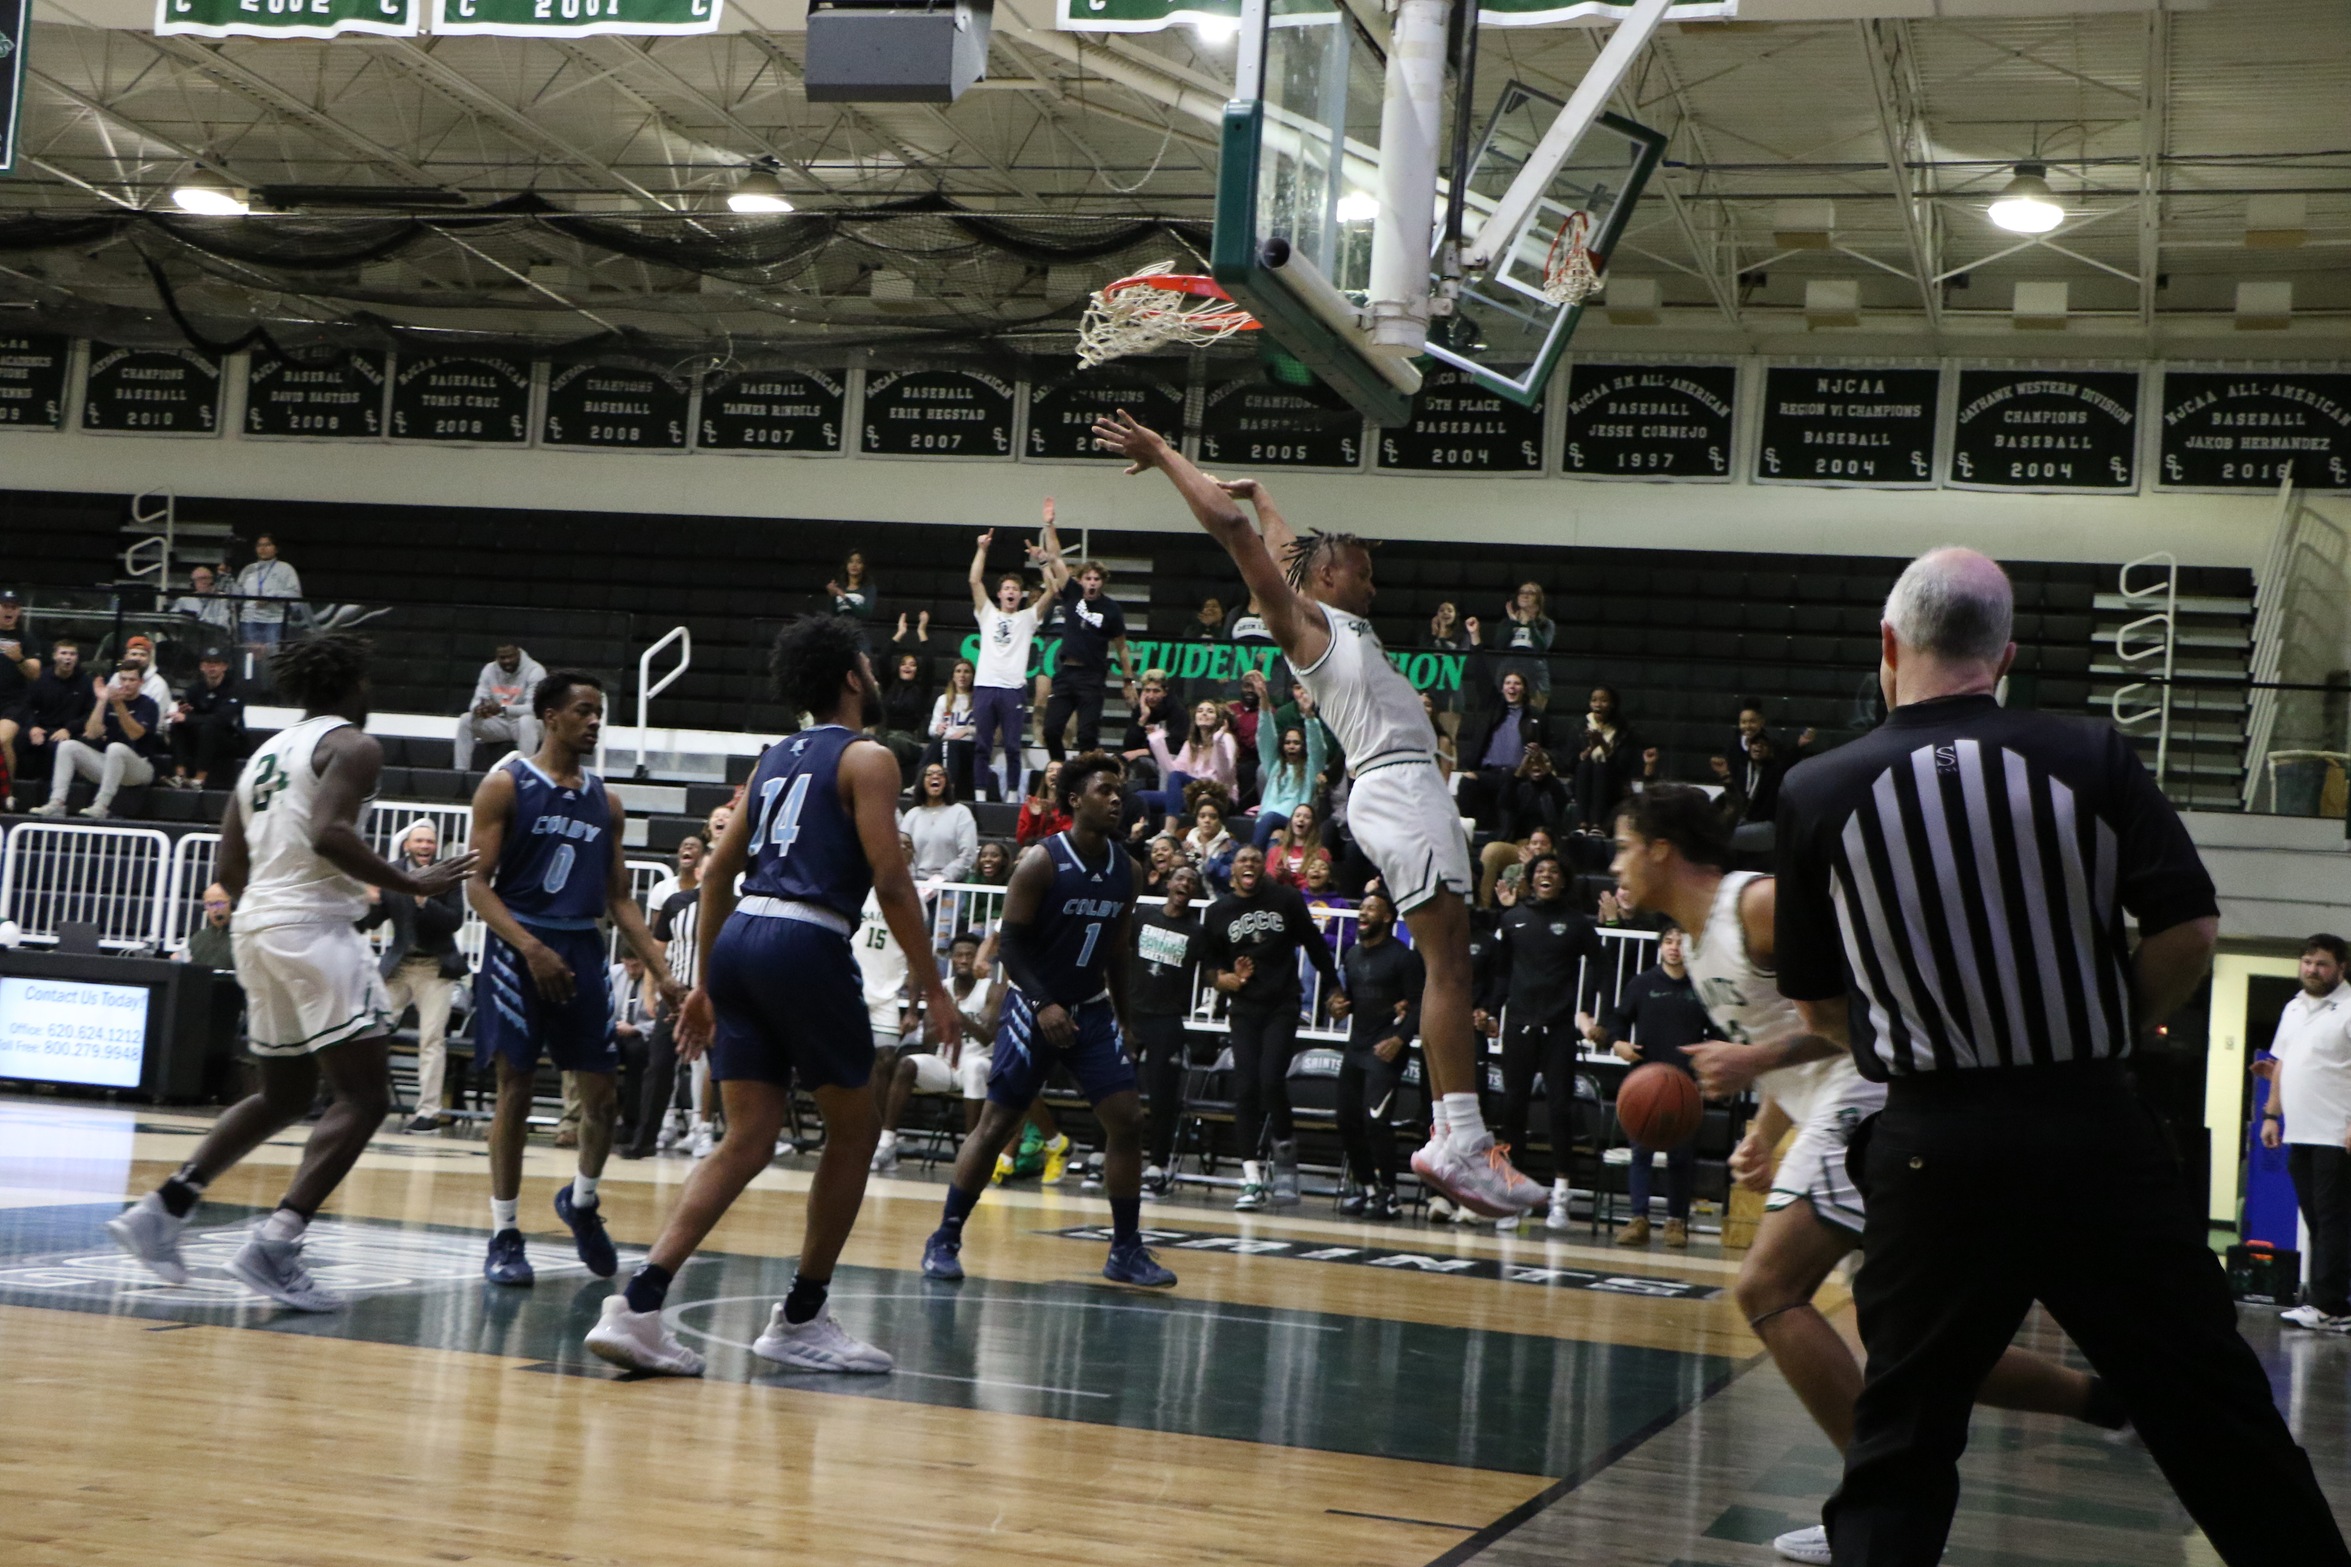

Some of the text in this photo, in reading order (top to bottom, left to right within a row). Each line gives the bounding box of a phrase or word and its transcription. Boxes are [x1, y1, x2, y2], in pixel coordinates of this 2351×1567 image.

[121, 368, 184, 380] CHAMPIONS
[283, 370, 343, 383] BASEBAL
[430, 374, 497, 388] BASEBALL
[740, 383, 806, 396] BASEBALL
[902, 387, 974, 400] BASEBALL
[1817, 378, 1886, 394] NJCAA
[115, 388, 187, 401] BASEBALL
[1244, 394, 1319, 409] CHAMPIO
[1568, 383, 1611, 415] NJCAA
[1639, 374, 1731, 419] ALL-AMERICAN
[584, 401, 651, 415] BASEBALL
[722, 402, 767, 416] TANNER
[1459, 399, 1503, 412] PLACE
[1608, 402, 1691, 416] BASEBALL
[1779, 402, 1923, 418] REGION VI CHAMPIONS
[1959, 381, 2134, 426] JAYHAWK WESTERN DIVISION
[2165, 383, 2351, 427] NJCAA ALL-AMERICAN
[127, 412, 174, 425] 2010
[889, 407, 986, 421] ERIK HEGSTAD
[2003, 410, 2088, 425] CHAMPIONS
[2211, 412, 2306, 426] BASEBALL
[290, 415, 339, 430] 2008
[435, 419, 482, 434] 2008
[1416, 421, 1507, 435] BASEBALL
[590, 425, 641, 441] 2008
[743, 428, 795, 443] 2007
[1588, 424, 1708, 440] JESSE CORNEJO
[1803, 431, 1891, 446] BASEBALL
[910, 434, 962, 449] 2007
[1994, 434, 2093, 449] BASEBALL
[2184, 436, 2331, 451] JAKOB HERNANDEZ
[1251, 444, 1307, 460] 2005
[1431, 448, 1489, 464] 2004
[1617, 453, 1674, 469] 1997
[1815, 458, 1876, 475] 2004
[2010, 462, 2074, 479] 2004
[748, 773, 812, 857] 14
[531, 815, 602, 843] COLBY
[543, 843, 576, 894] 0
[1063, 898, 1125, 918] COLBY
[1228, 910, 1285, 943] SCCC
[866, 926, 888, 950] 15
[1076, 922, 1102, 967] 1
[25, 985, 78, 1004] Contact
[81, 990, 98, 1005] Us
